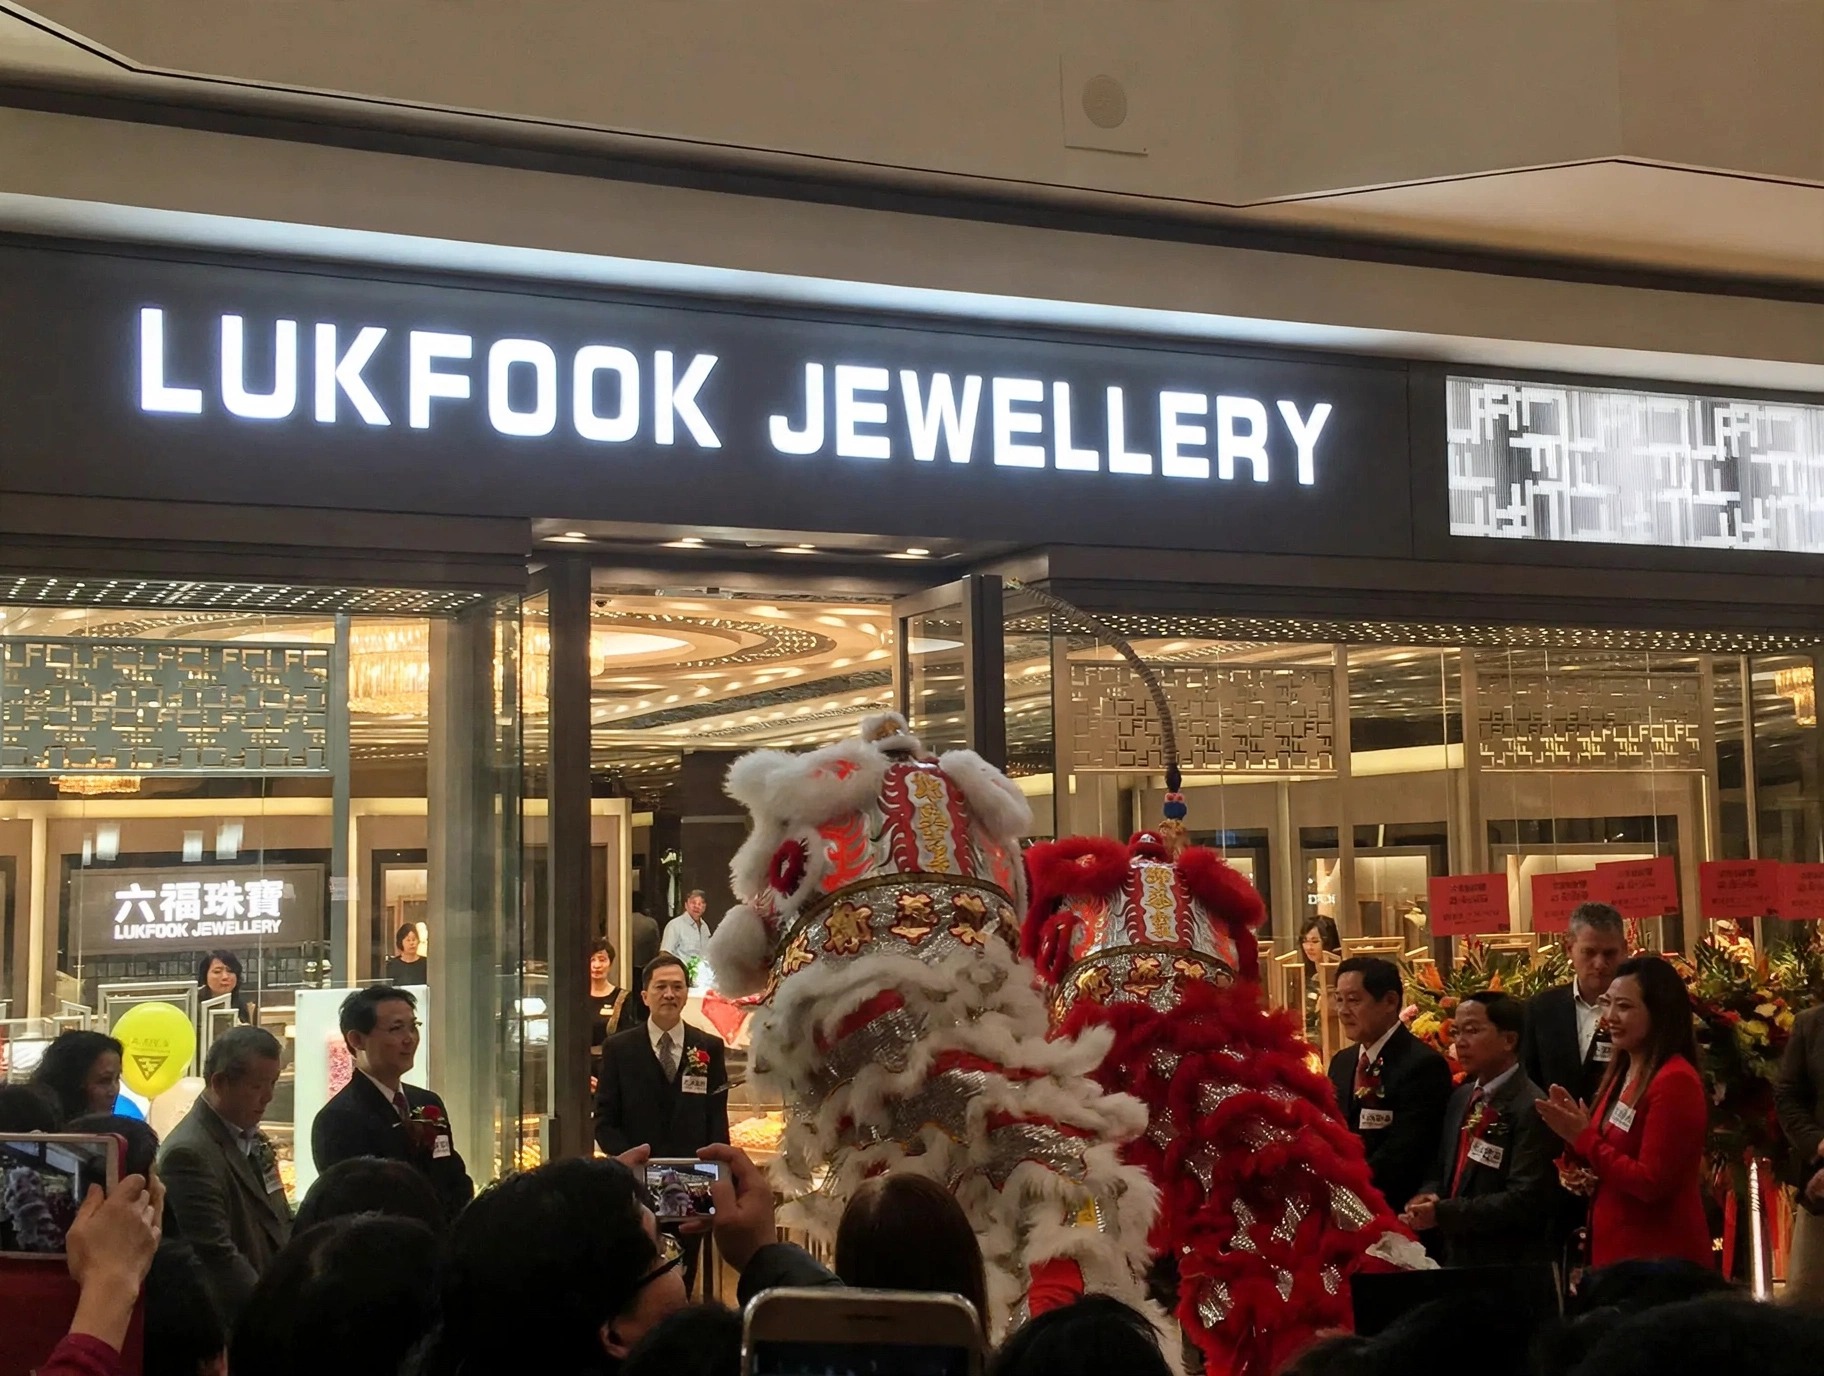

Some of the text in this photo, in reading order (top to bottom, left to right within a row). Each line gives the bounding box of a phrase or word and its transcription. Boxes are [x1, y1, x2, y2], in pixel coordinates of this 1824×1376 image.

[140, 307, 1333, 486] LUKFOOK JEWELLERY
[114, 879, 284, 923] 六福珠寶
[113, 919, 282, 940] LUKFOOK JEWELLERY
